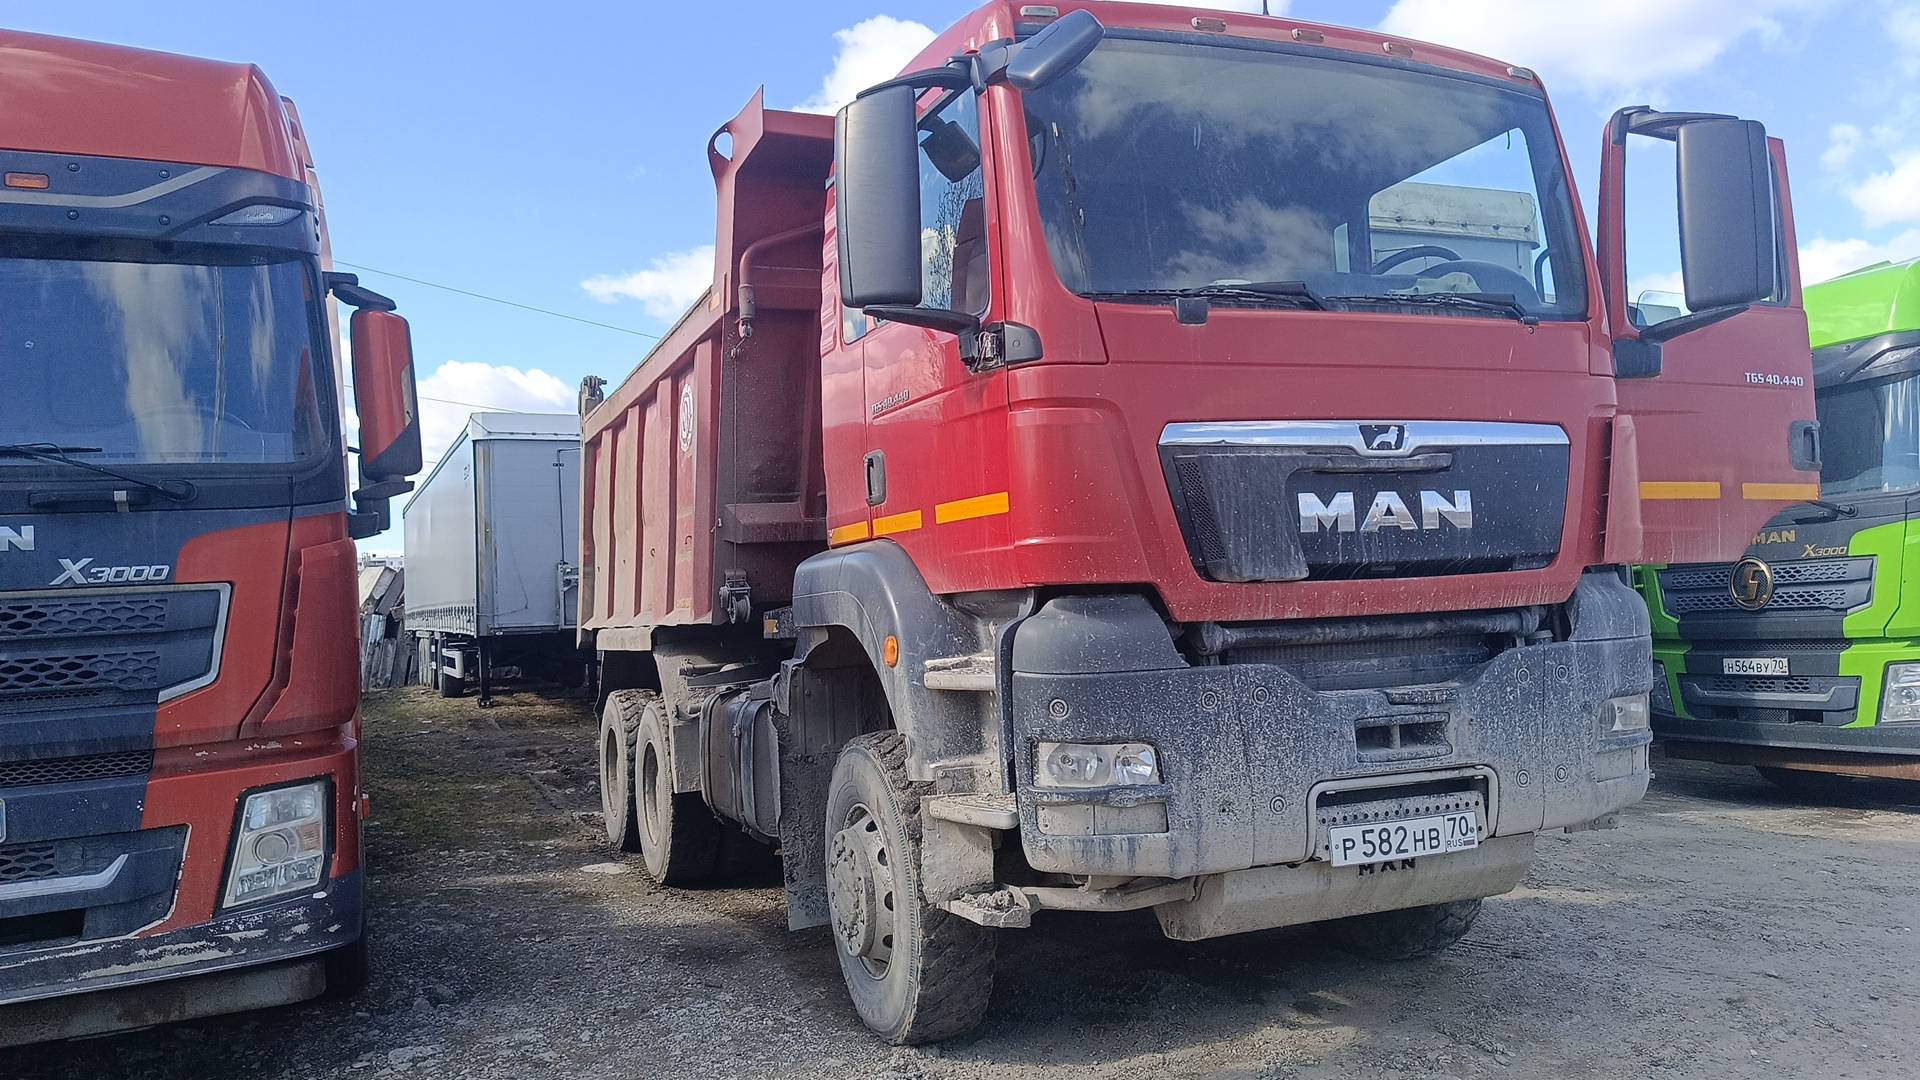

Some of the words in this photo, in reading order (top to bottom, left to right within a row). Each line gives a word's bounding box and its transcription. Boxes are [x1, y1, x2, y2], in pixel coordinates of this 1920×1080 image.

[1298, 490, 1473, 533] MAN
[1801, 543, 1848, 558] X3000
[49, 557, 170, 586] X3000
[1447, 815, 1469, 839] 70
